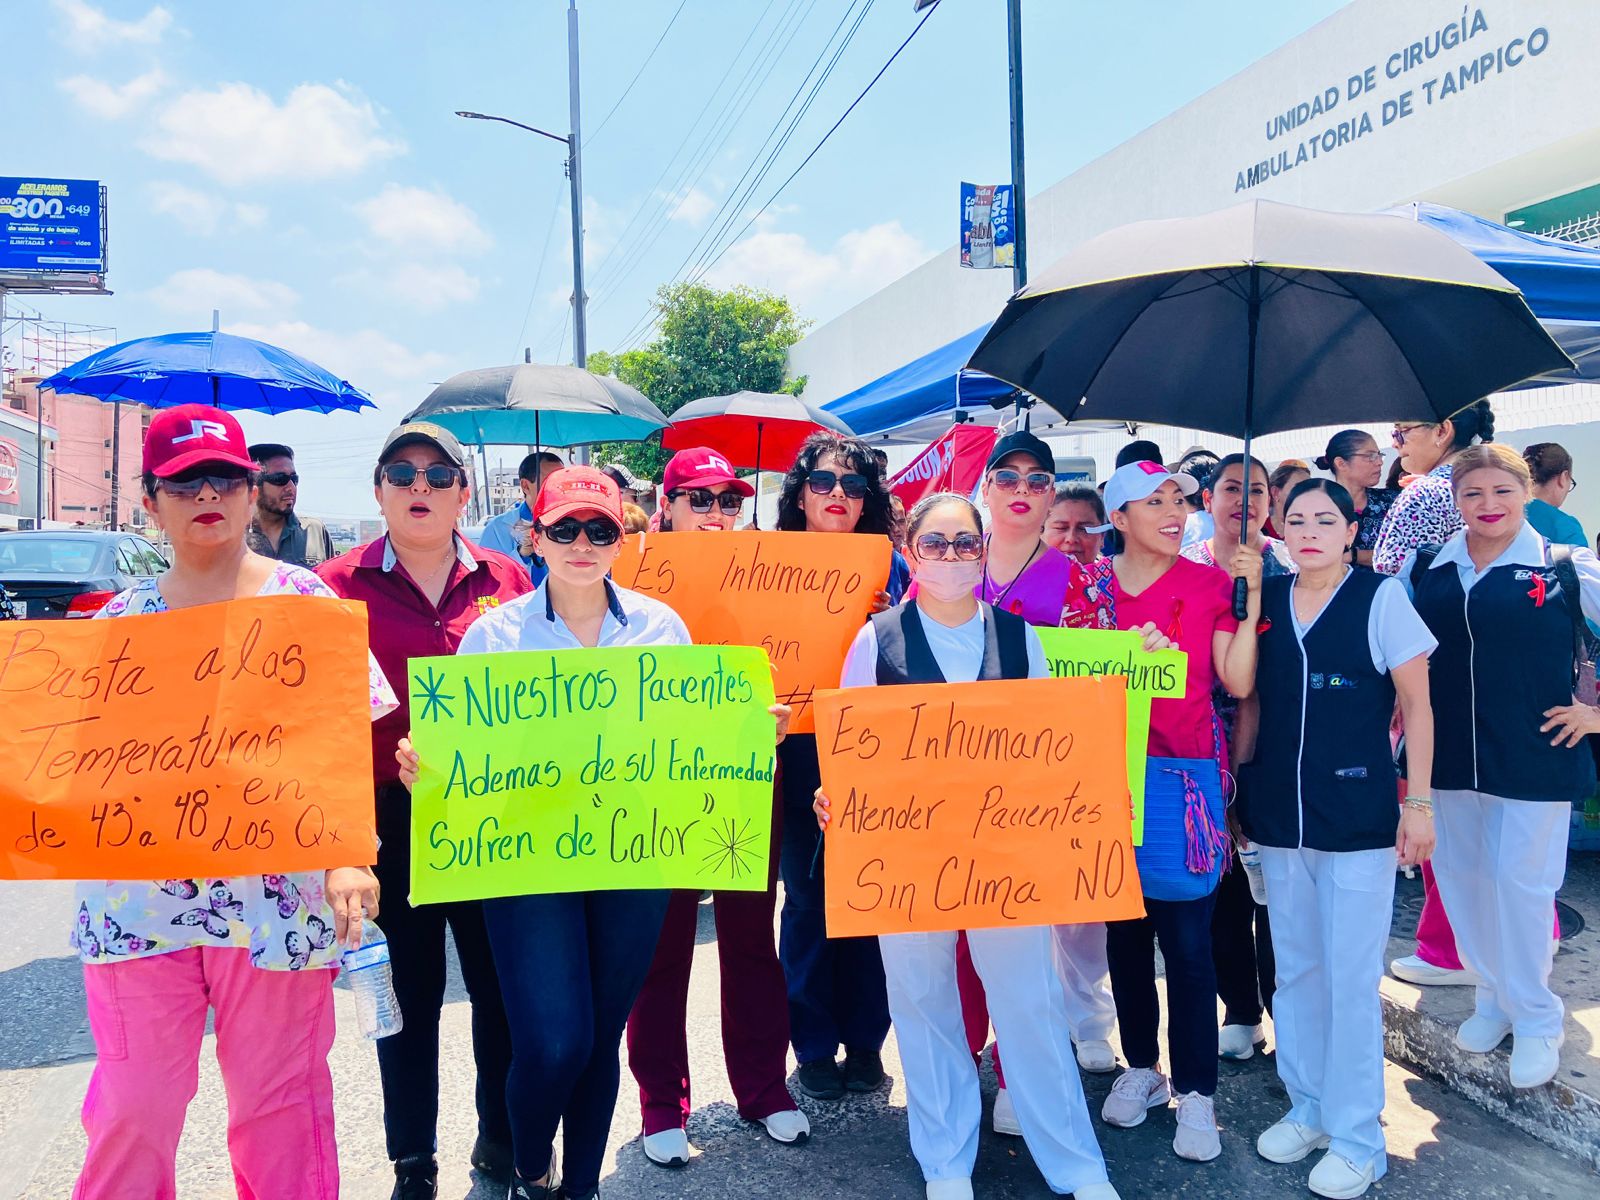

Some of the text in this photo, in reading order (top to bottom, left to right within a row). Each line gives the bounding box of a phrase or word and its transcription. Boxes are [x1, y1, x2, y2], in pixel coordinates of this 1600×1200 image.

[1266, 4, 1489, 141] UNIDAD DE CIRUGÍA
[1234, 26, 1550, 193] AMBULATORIA DE TAMPICO
[9, 197, 63, 219] 300
[18, 183, 68, 191] ACELERAMOS
[632, 547, 675, 594] Es
[0, 618, 306, 702] Basta a las
[464, 652, 753, 728] Nuestros Pacientes
[20, 715, 283, 789] Temperaturas
[444, 750, 562, 800] Ademas
[580, 734, 617, 785] de
[668, 737, 774, 783] Enfermedad
[832, 701, 1074, 767] Es Inhumano
[15, 811, 66, 852] de
[139, 831, 157, 848] a
[243, 776, 305, 805] en
[212, 816, 274, 852] Los
[429, 816, 535, 871] Sufren
[555, 813, 597, 860] de
[839, 786, 946, 834] Atender
[847, 858, 916, 923] Sin
[934, 855, 1041, 920] Clima
